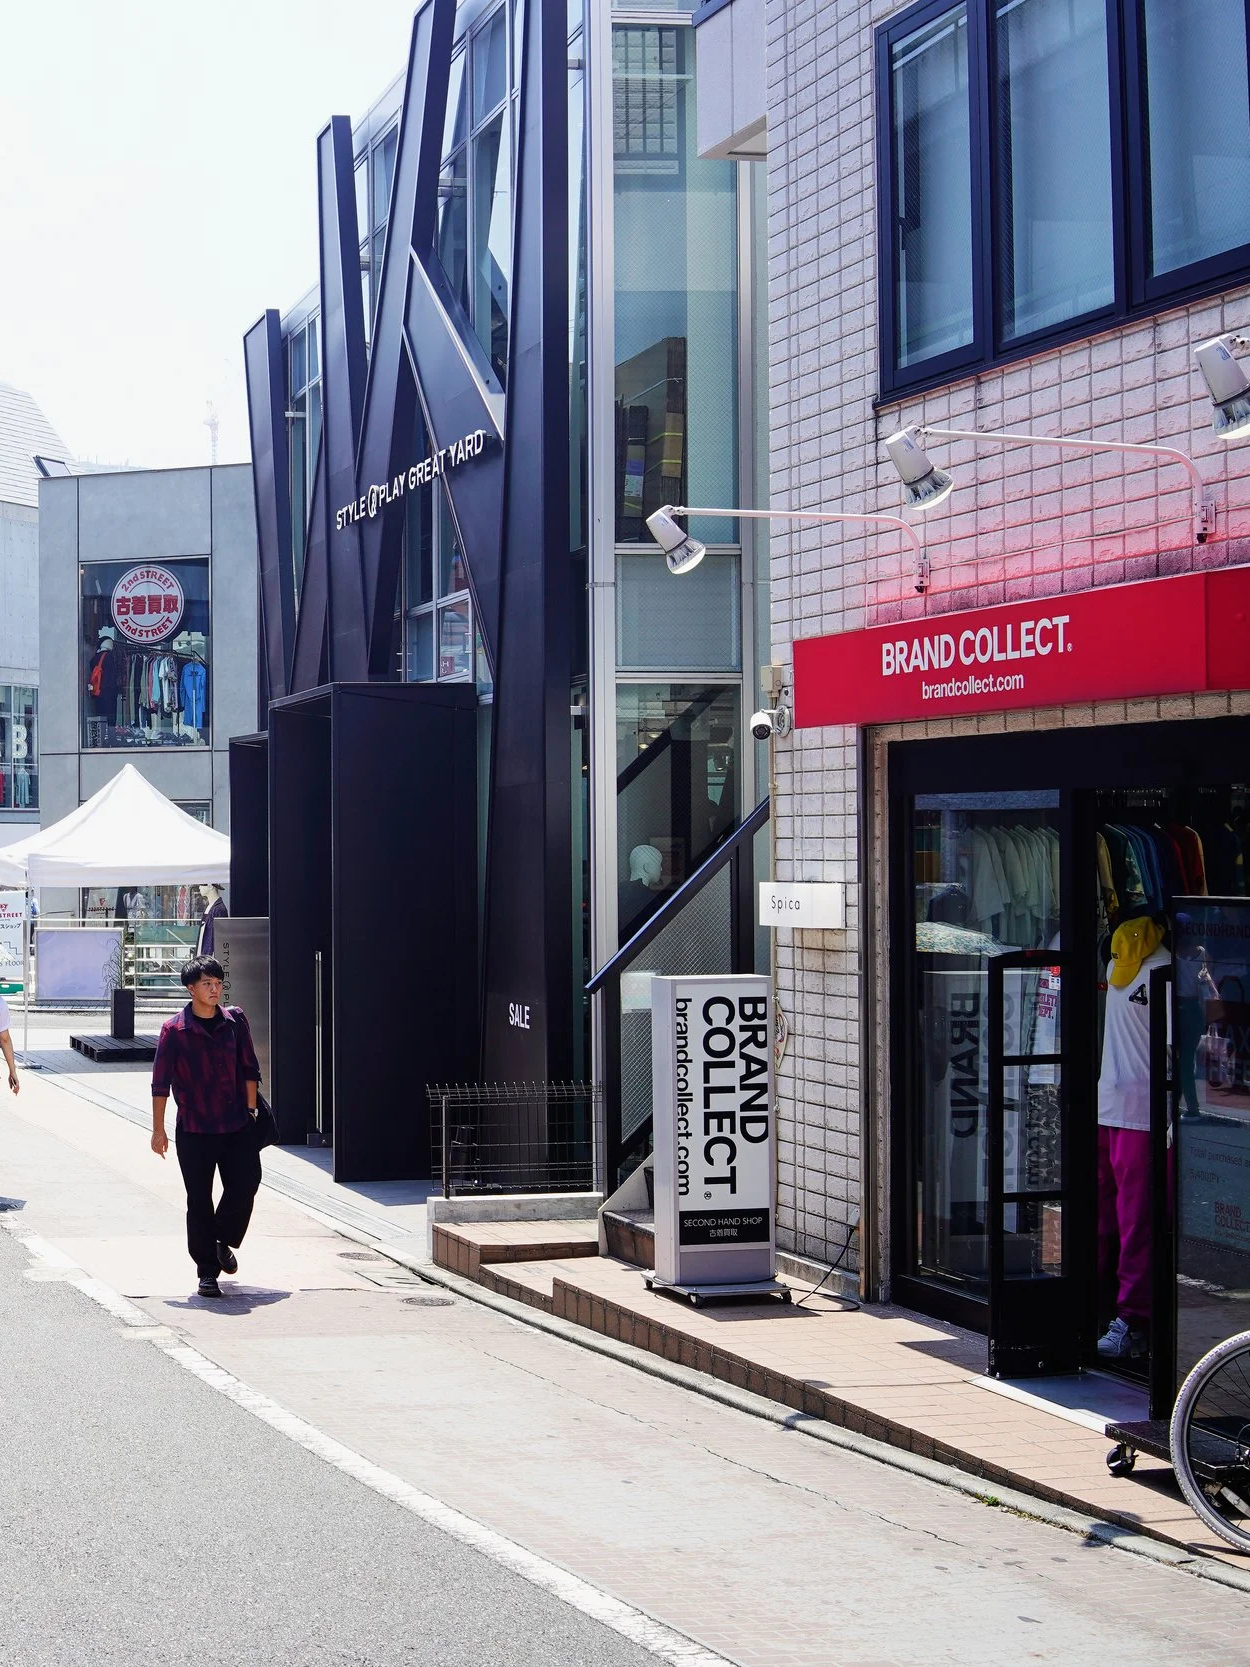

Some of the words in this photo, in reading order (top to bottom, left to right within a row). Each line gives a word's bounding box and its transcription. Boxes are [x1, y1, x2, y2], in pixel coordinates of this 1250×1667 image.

[336, 496, 366, 530] STYLE
[379, 471, 406, 507] PLAY
[408, 449, 446, 490] GREAT
[449, 430, 486, 467] YARD
[121, 573, 139, 592] 2nd
[139, 570, 174, 590] STREET
[116, 594, 178, 616] 古着買取
[121, 618, 138, 636] 2nd
[137, 616, 173, 638] STREET
[882, 633, 955, 676] BRAND
[922, 674, 1024, 700] brandcollect.com
[771, 895, 800, 914] Spica
[508, 1002, 530, 1029] SALE
[738, 996, 769, 1144] BRAND
[675, 998, 694, 1196] brandcollect.com
[702, 996, 737, 1194] COLLECT
[684, 1218, 716, 1227] SECOND
[718, 1217, 741, 1226] HAND
[743, 1216, 763, 1226] SHOP
